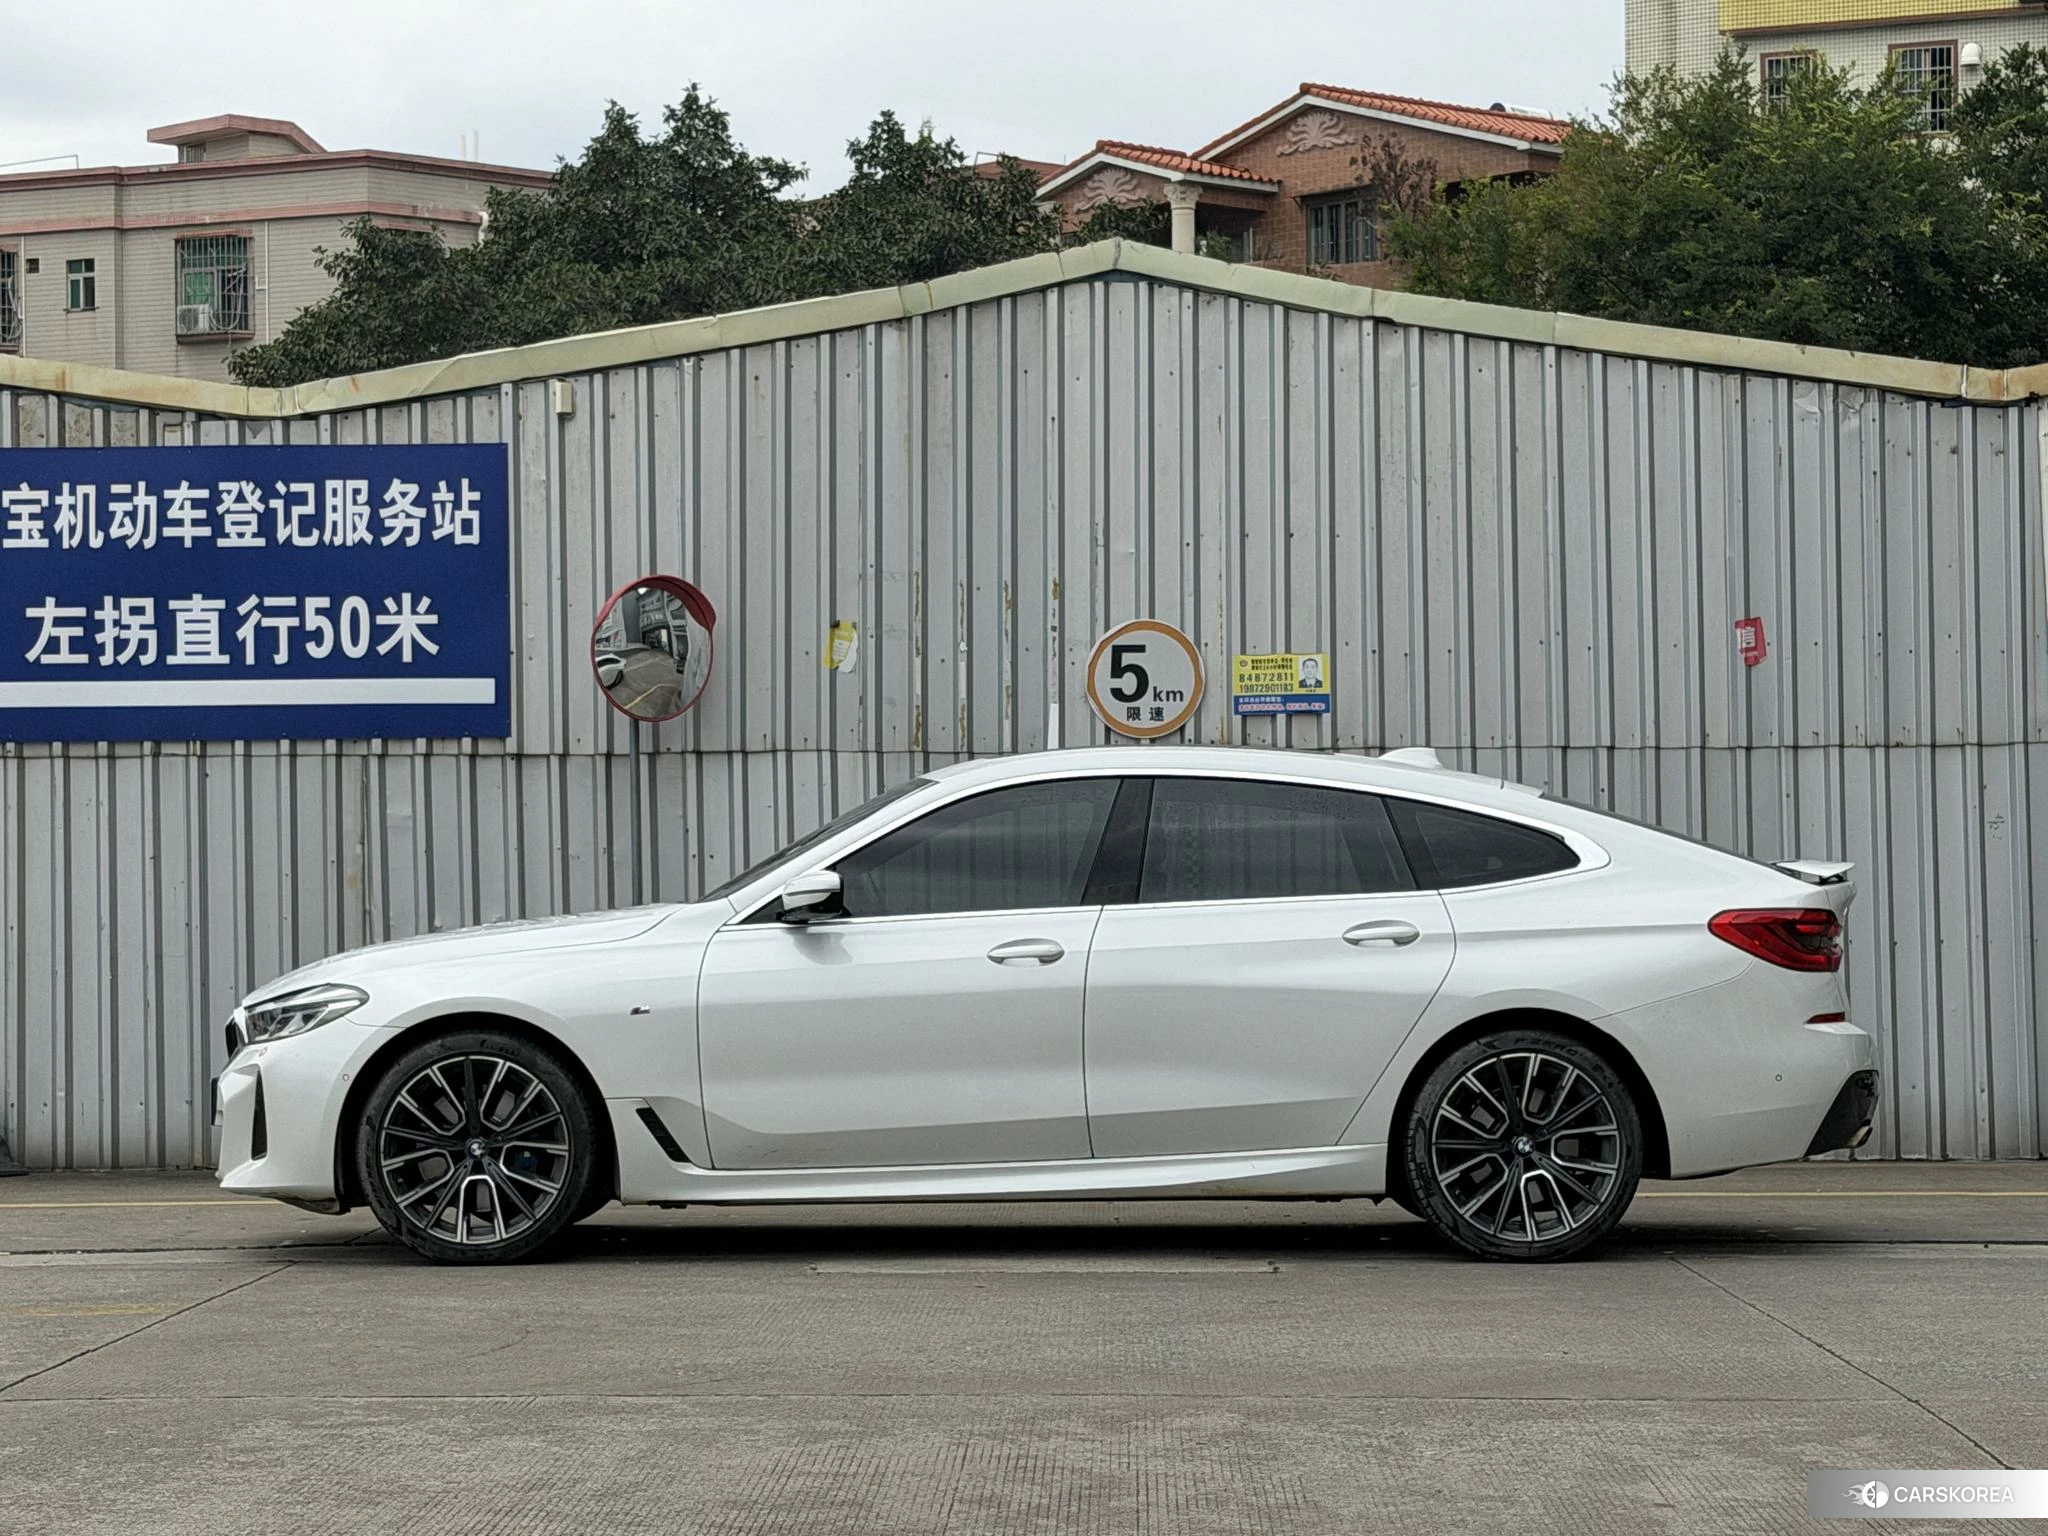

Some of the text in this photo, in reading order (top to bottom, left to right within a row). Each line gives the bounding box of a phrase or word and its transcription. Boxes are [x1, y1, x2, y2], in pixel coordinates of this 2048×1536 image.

[2, 478, 481, 549] 宝机动车登记服务站
[25, 592, 440, 667] 左拐直行50米
[1109, 644, 1184, 704] 5 km
[1239, 672, 1294, 683] 84872811
[1126, 706, 1165, 722] 限速
